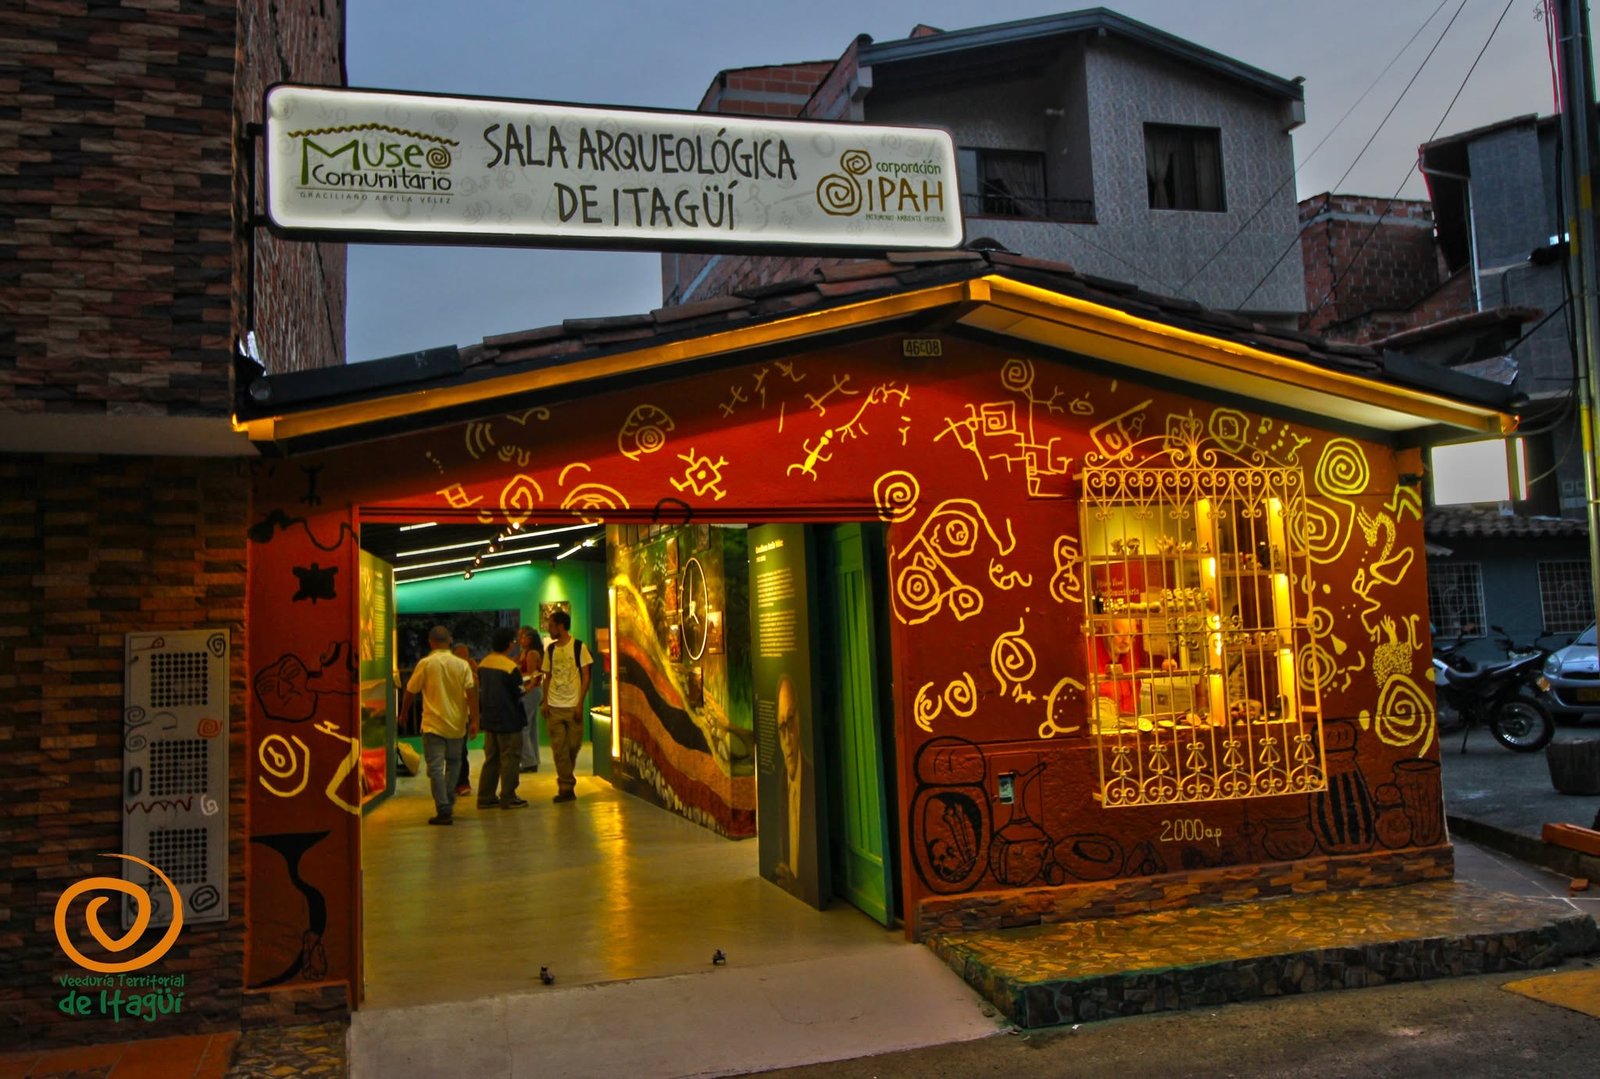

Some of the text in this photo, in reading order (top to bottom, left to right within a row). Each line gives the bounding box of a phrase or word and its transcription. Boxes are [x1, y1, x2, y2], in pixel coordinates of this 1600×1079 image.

[484, 123, 798, 181] SALA ARQUEOLÓGICA
[875, 160, 942, 178] corporación
[312, 164, 452, 191] Comunitario
[554, 181, 738, 230] DE ITAGÜÍ
